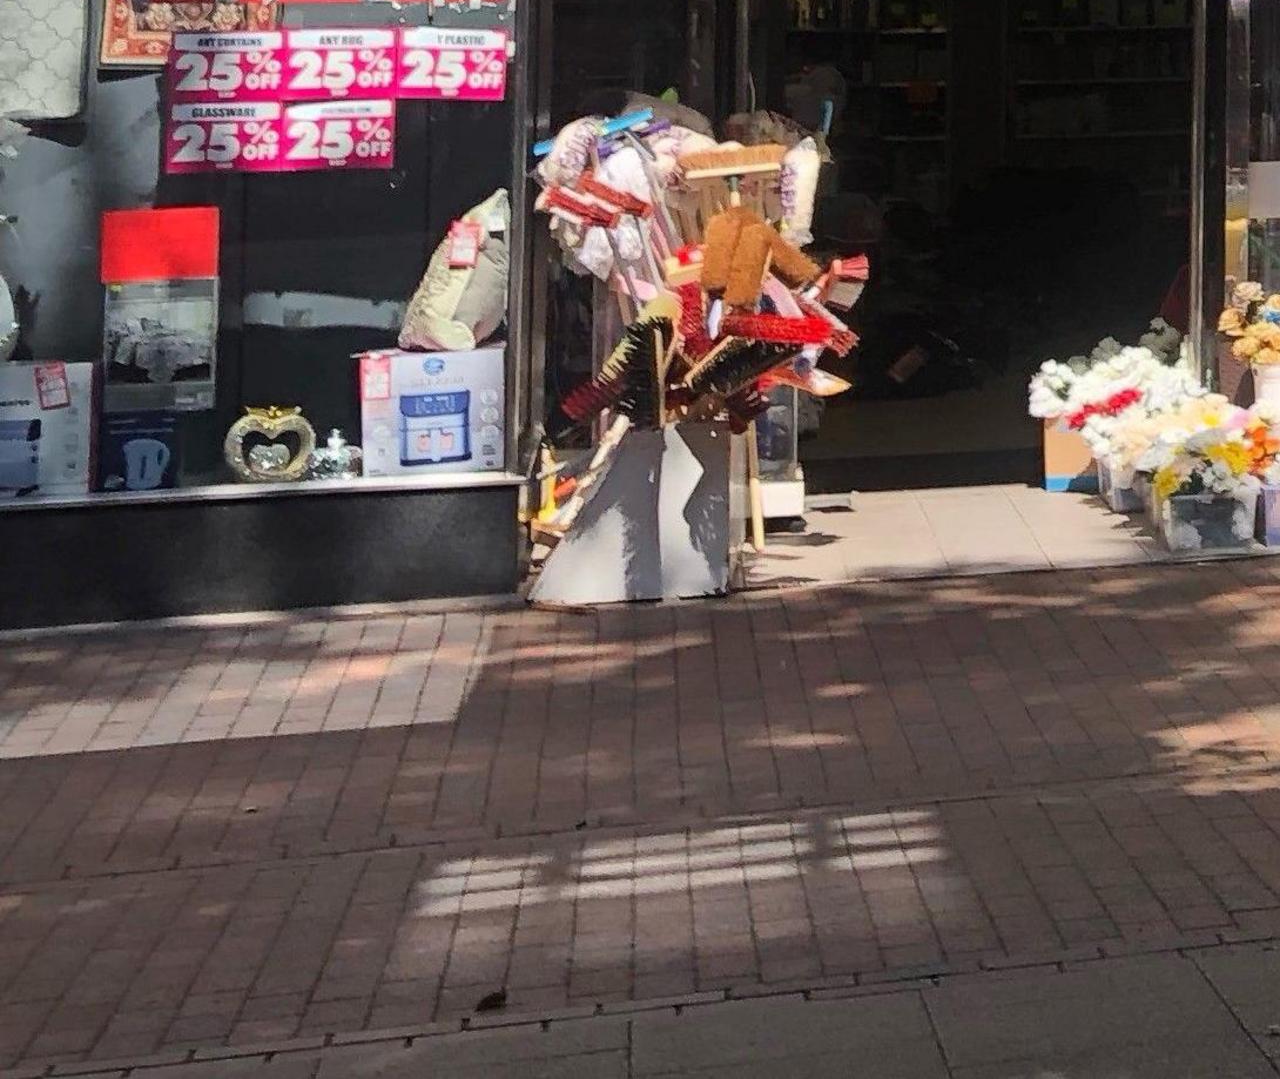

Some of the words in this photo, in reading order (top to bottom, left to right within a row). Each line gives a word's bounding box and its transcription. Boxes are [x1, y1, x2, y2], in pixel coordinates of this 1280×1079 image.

[245, 73, 282, 90] OFF
[357, 71, 393, 88] OFF
[468, 72, 502, 89] OFF
[243, 143, 280, 160] OFF
[356, 140, 392, 158] OFF
